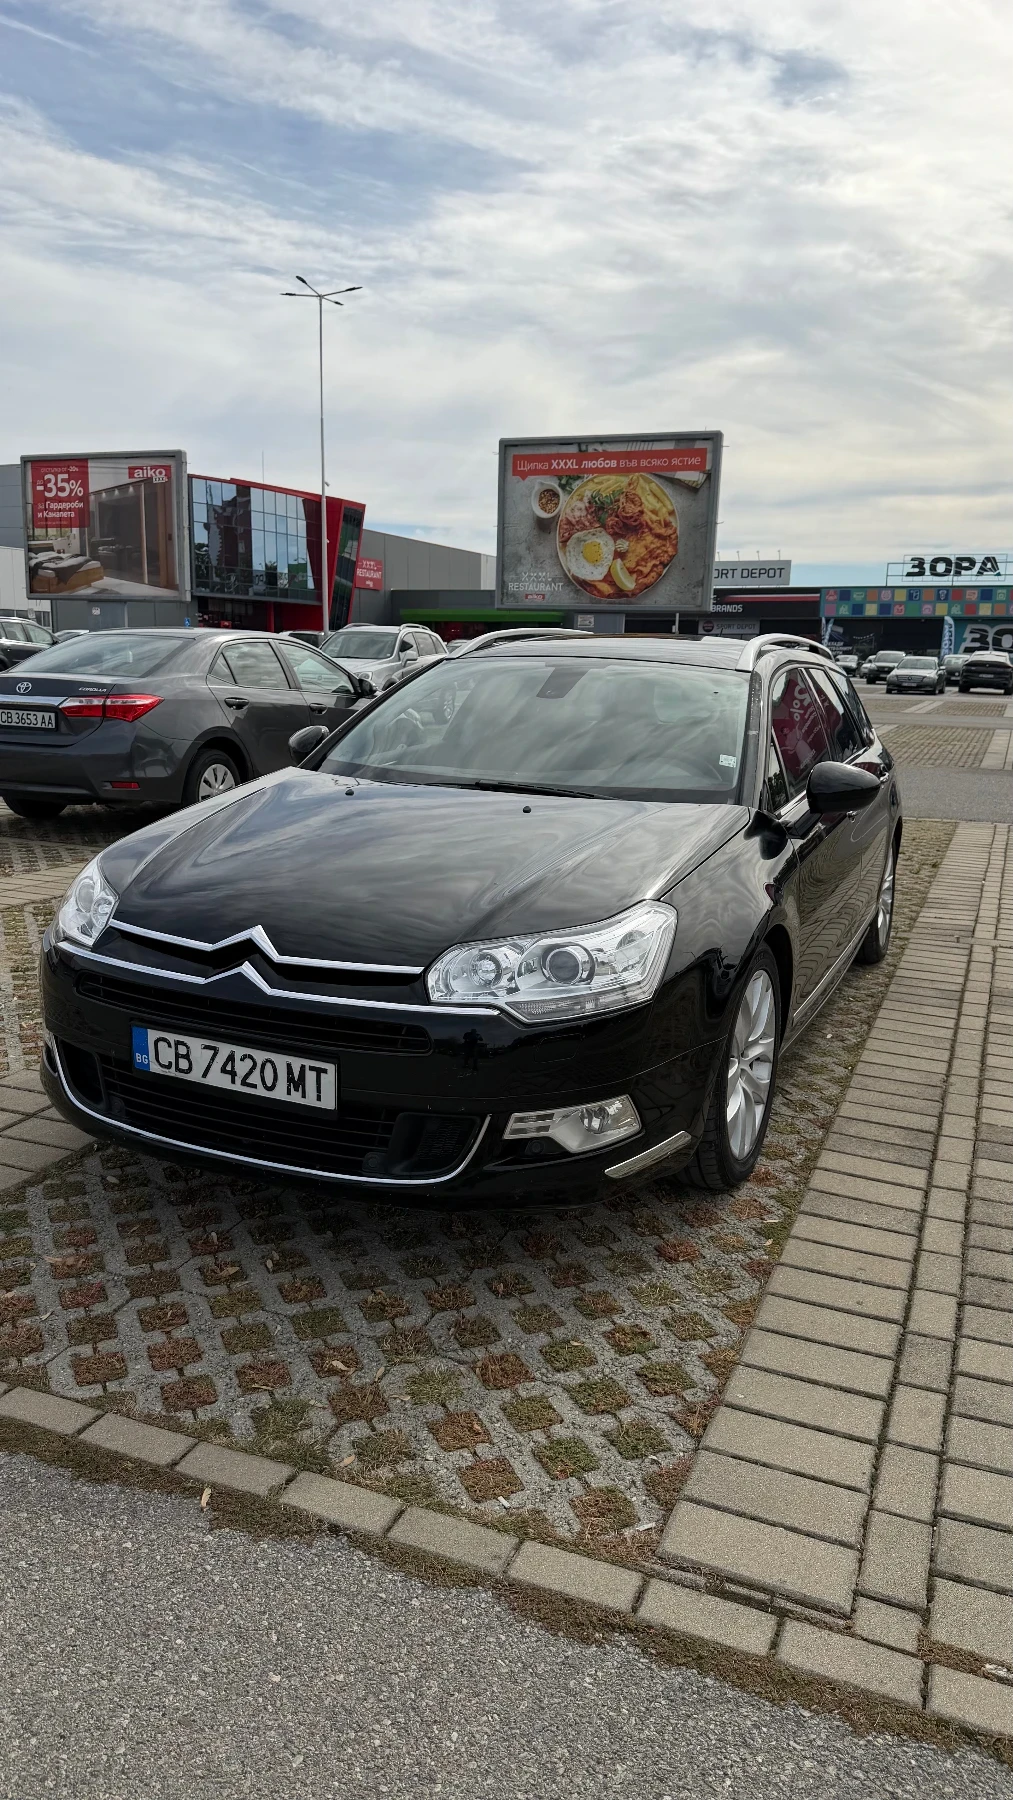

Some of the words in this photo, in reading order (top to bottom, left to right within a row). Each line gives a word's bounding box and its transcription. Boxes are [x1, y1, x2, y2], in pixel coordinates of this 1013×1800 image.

[517, 460, 549, 471] Щипка
[551, 459, 579, 469] XXXL
[581, 457, 617, 469] любов
[620, 459, 638, 468] във
[640, 458, 669, 467] всяко
[671, 457, 701, 466] ястие
[134, 466, 166, 478] aiko
[36, 473, 84, 498] -35%
[46, 500, 84, 511] Гардероби
[43, 510, 75, 518] Канапета
[905, 556, 1003, 577] ЗОРА
[356, 568, 382, 579] RESTAURANT
[521, 572, 553, 582] XXXL
[740, 567, 785, 579] DEPOT
[508, 582, 564, 591] RESTAURANT
[711, 604, 743, 613] BRANDS
[0, 710, 13, 724] CB
[14, 711, 39, 726] 3653
[40, 713, 54, 728] AA
[136, 1052, 149, 1065] BG
[153, 1036, 193, 1075] CB
[200, 1043, 279, 1092] 7420
[286, 1060, 329, 1102] MT
